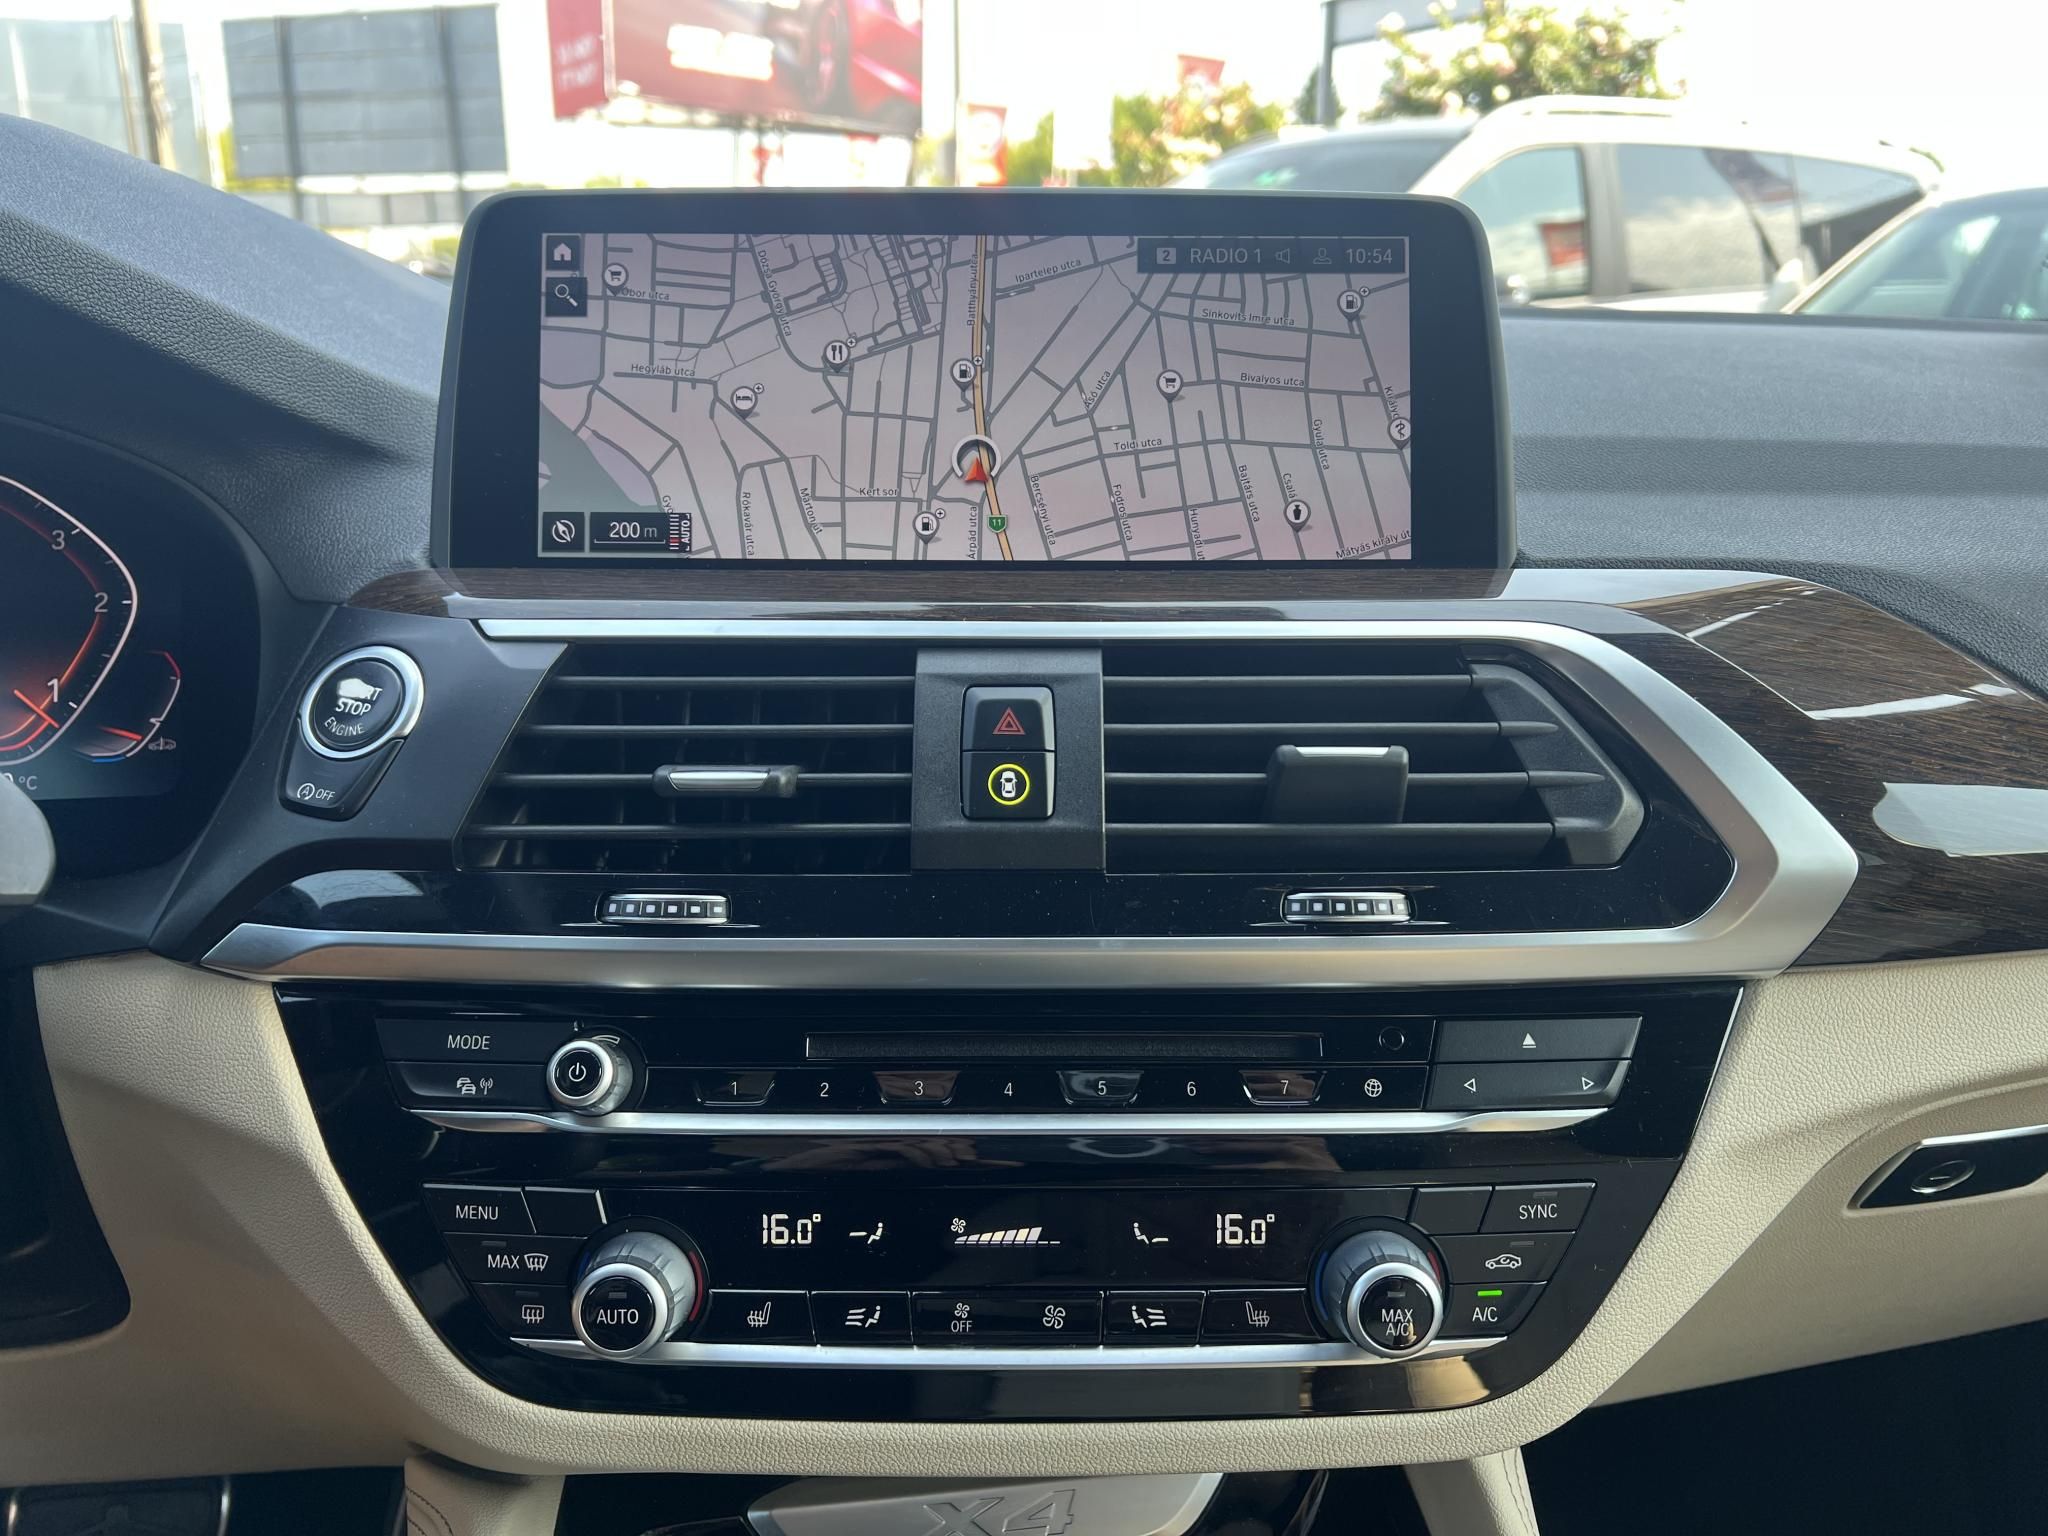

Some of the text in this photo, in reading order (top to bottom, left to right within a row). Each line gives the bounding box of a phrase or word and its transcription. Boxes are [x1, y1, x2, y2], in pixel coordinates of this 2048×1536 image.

[1162, 250, 1171, 262] 2
[1190, 249, 1261, 263] RADIO 1
[1347, 249, 1392, 264] 10:54
[1015, 260, 1082, 283] Ipartelep utca
[649, 291, 670, 300] utca
[1202, 308, 1295, 326] Sinkovits Imre utca
[780, 316, 791, 337] utca
[631, 363, 695, 377] Hegyláb utca
[1096, 370, 1111, 391] utca
[1240, 372, 1304, 387] Bivalyos utca
[1113, 438, 1162, 451] Toldi utca
[1313, 419, 1330, 470] Gyula utca
[860, 487, 897, 496] Kert sor
[1030, 475, 1056, 546] Bercsényi utca
[1112, 484, 1133, 541] Fodros utca
[1248, 501, 1260, 522] utca
[609, 522, 657, 538] 200 m
[681, 520, 690, 544] AUTO
[967, 506, 977, 560] Árpád utca
[1189, 508, 1202, 549] Hunyadi
[51, 530, 66, 551] 3
[746, 534, 755, 556] utca
[93, 592, 109, 613] 2
[47, 678, 59, 703] 1
[335, 699, 372, 717] STOP
[324, 716, 366, 737] ENGINE
[315, 788, 336, 801] OFF
[447, 1034, 491, 1050] MODE
[731, 1081, 738, 1096] 1
[819, 1082, 830, 1097] 2
[914, 1081, 924, 1096] 3
[1003, 1082, 1014, 1097] 4
[1097, 1080, 1107, 1096] 5
[1186, 1082, 1196, 1097] 6
[1280, 1080, 1290, 1095] 7
[455, 1205, 499, 1221] MENU
[1518, 1204, 1558, 1220] SYNC
[487, 1254, 521, 1270] MAX
[596, 1309, 639, 1325] AUTO
[1381, 1309, 1413, 1323] MAX
[1473, 1307, 1498, 1322] A/C
[950, 1320, 973, 1333] OFF
[1385, 1322, 1410, 1337] A/C
[922, 1489, 1075, 1536] X4
